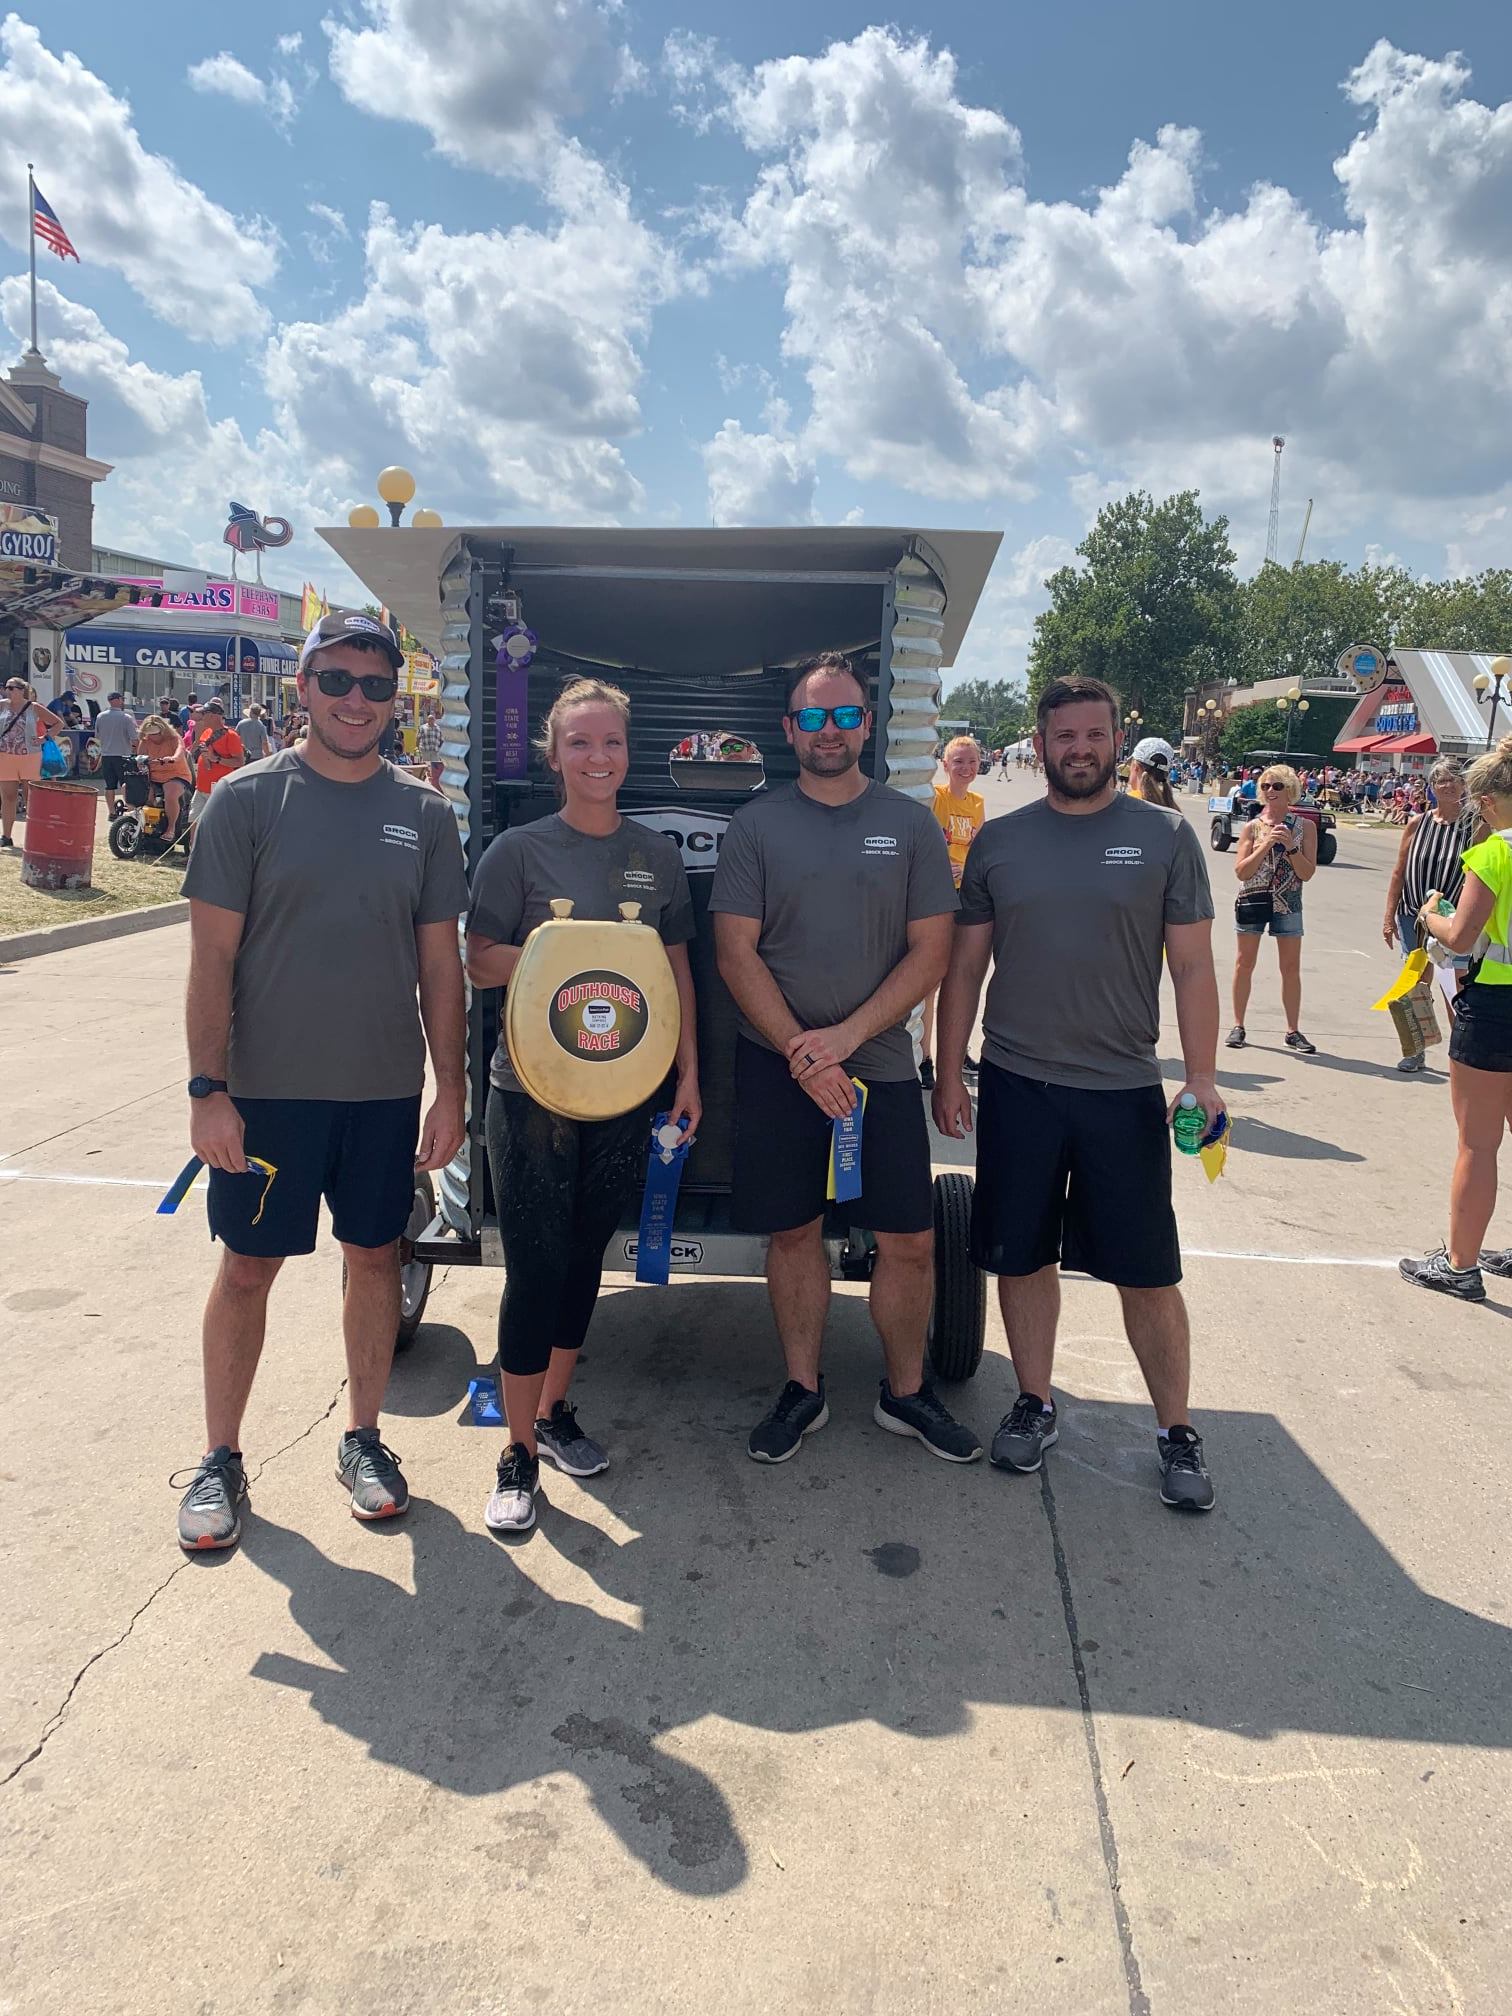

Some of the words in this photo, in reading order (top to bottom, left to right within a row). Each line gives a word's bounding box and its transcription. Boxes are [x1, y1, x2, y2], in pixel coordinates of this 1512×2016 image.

[1, 532, 53, 558] GYROS
[168, 587, 231, 607] EARS
[241, 586, 278, 604] ELEPHANT
[251, 606, 270, 616] EARS
[136, 648, 222, 670] CAKES
[260, 656, 280, 674] FUNNEL
[1376, 714, 1417, 732] COOKIES
[385, 826, 418, 839] BROCK
[625, 872, 654, 880] BROCK
[557, 982, 641, 1013] OUTHOUSE
[577, 1030, 620, 1051] RACE
[629, 1244, 698, 1258] BCK
